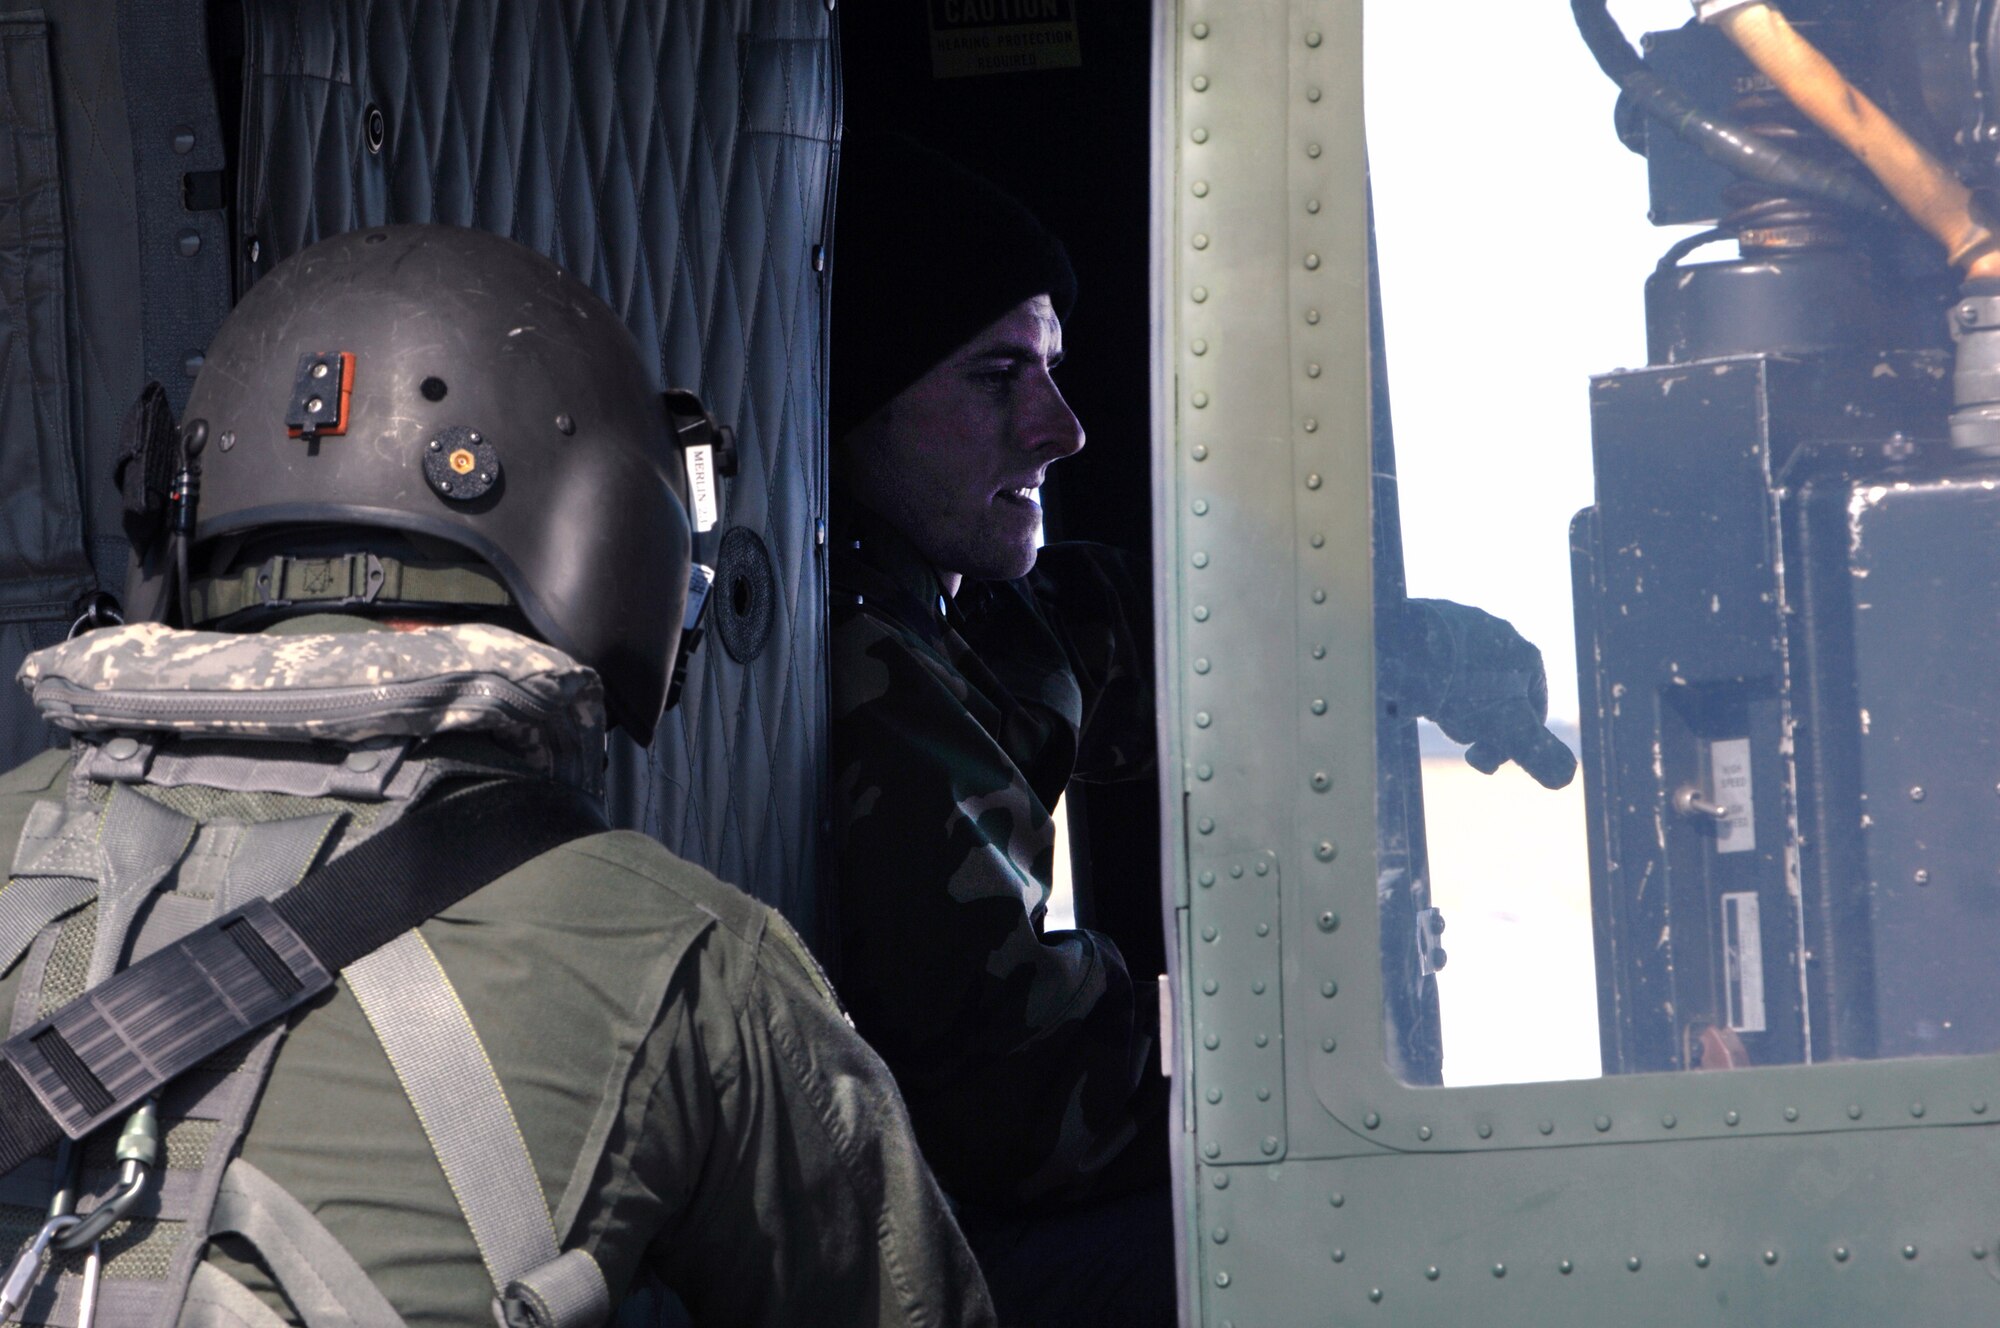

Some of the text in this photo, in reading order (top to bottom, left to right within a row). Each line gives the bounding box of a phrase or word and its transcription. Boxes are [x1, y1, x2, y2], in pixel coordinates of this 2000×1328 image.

[945, 0, 1058, 23] CAUTION
[937, 30, 1073, 51] HEARING PROTECTION
[977, 53, 1037, 70] REQUIRED
[693, 450, 706, 502] MERLIN
[1721, 776, 1746, 788] SPEED
